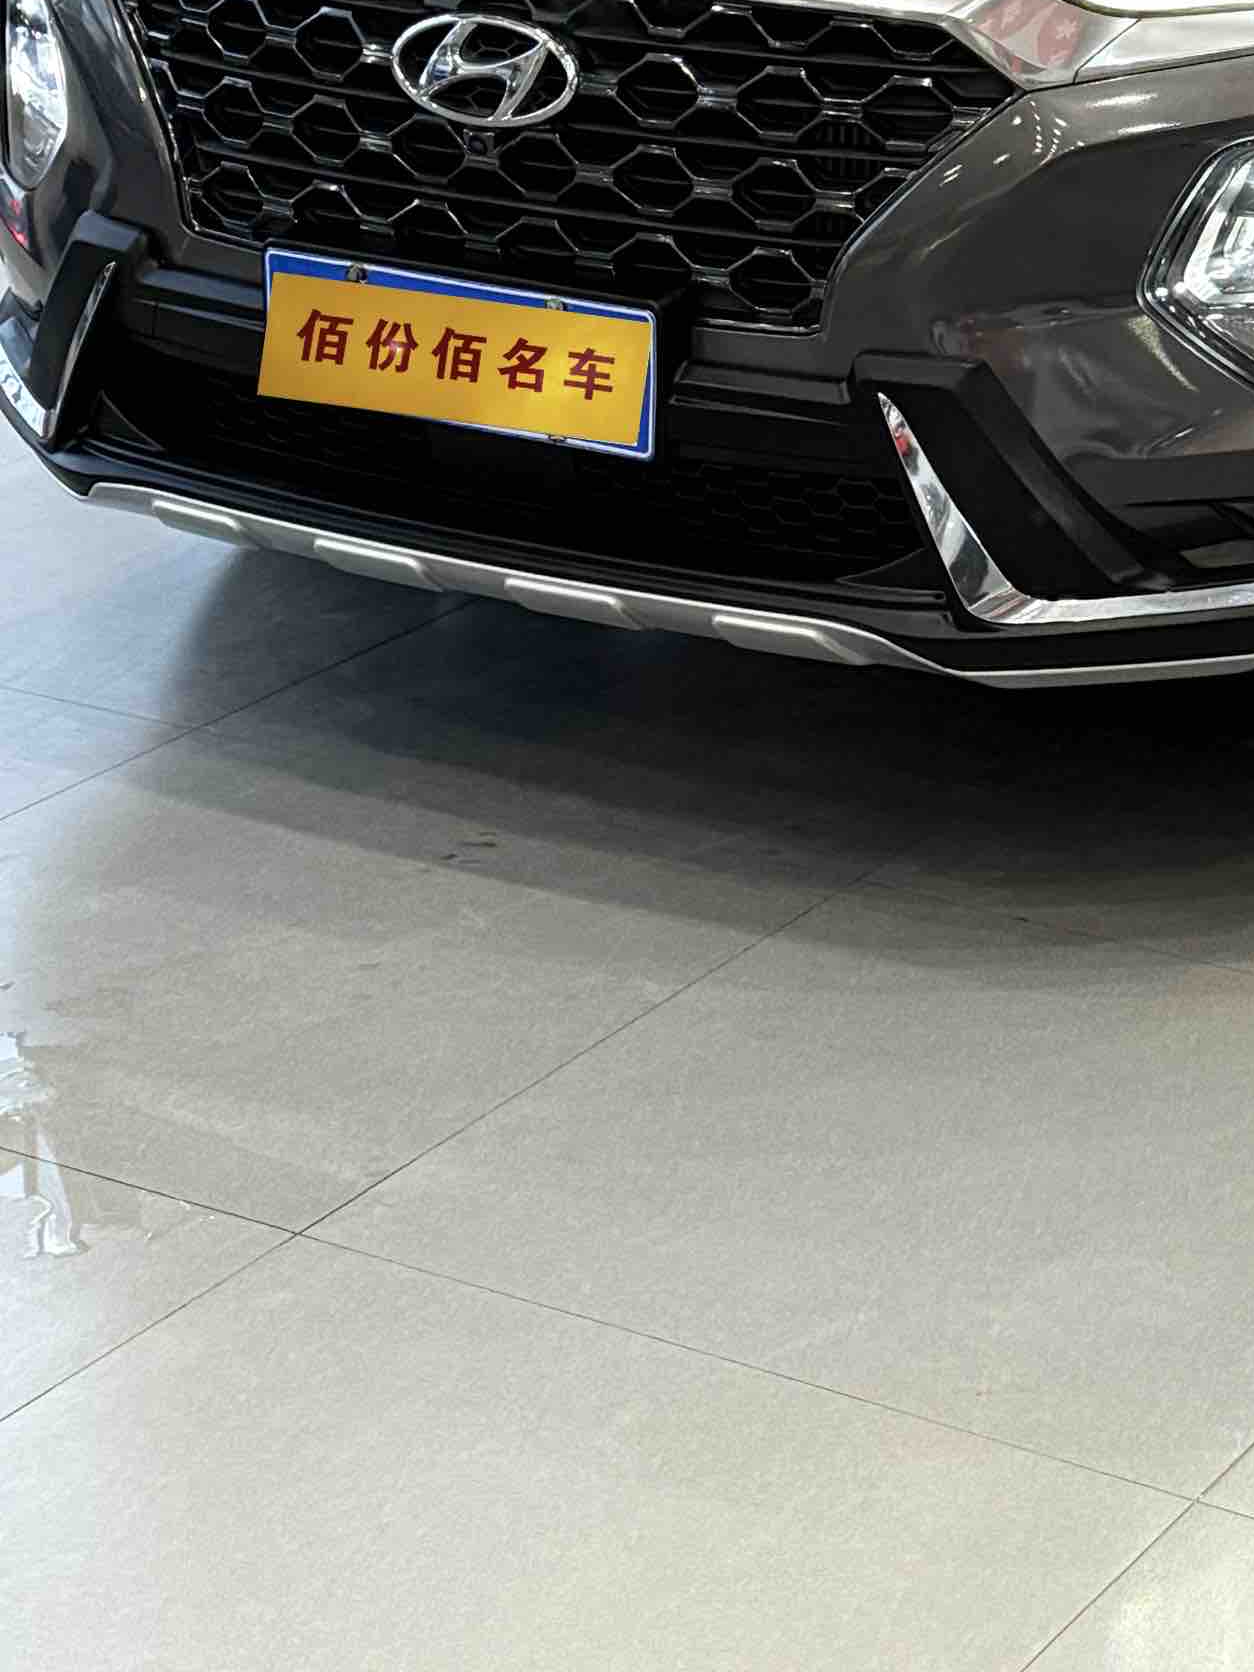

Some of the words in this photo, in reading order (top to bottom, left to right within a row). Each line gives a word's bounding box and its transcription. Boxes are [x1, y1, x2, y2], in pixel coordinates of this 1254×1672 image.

[297, 309, 615, 400] 佰份佰名车
